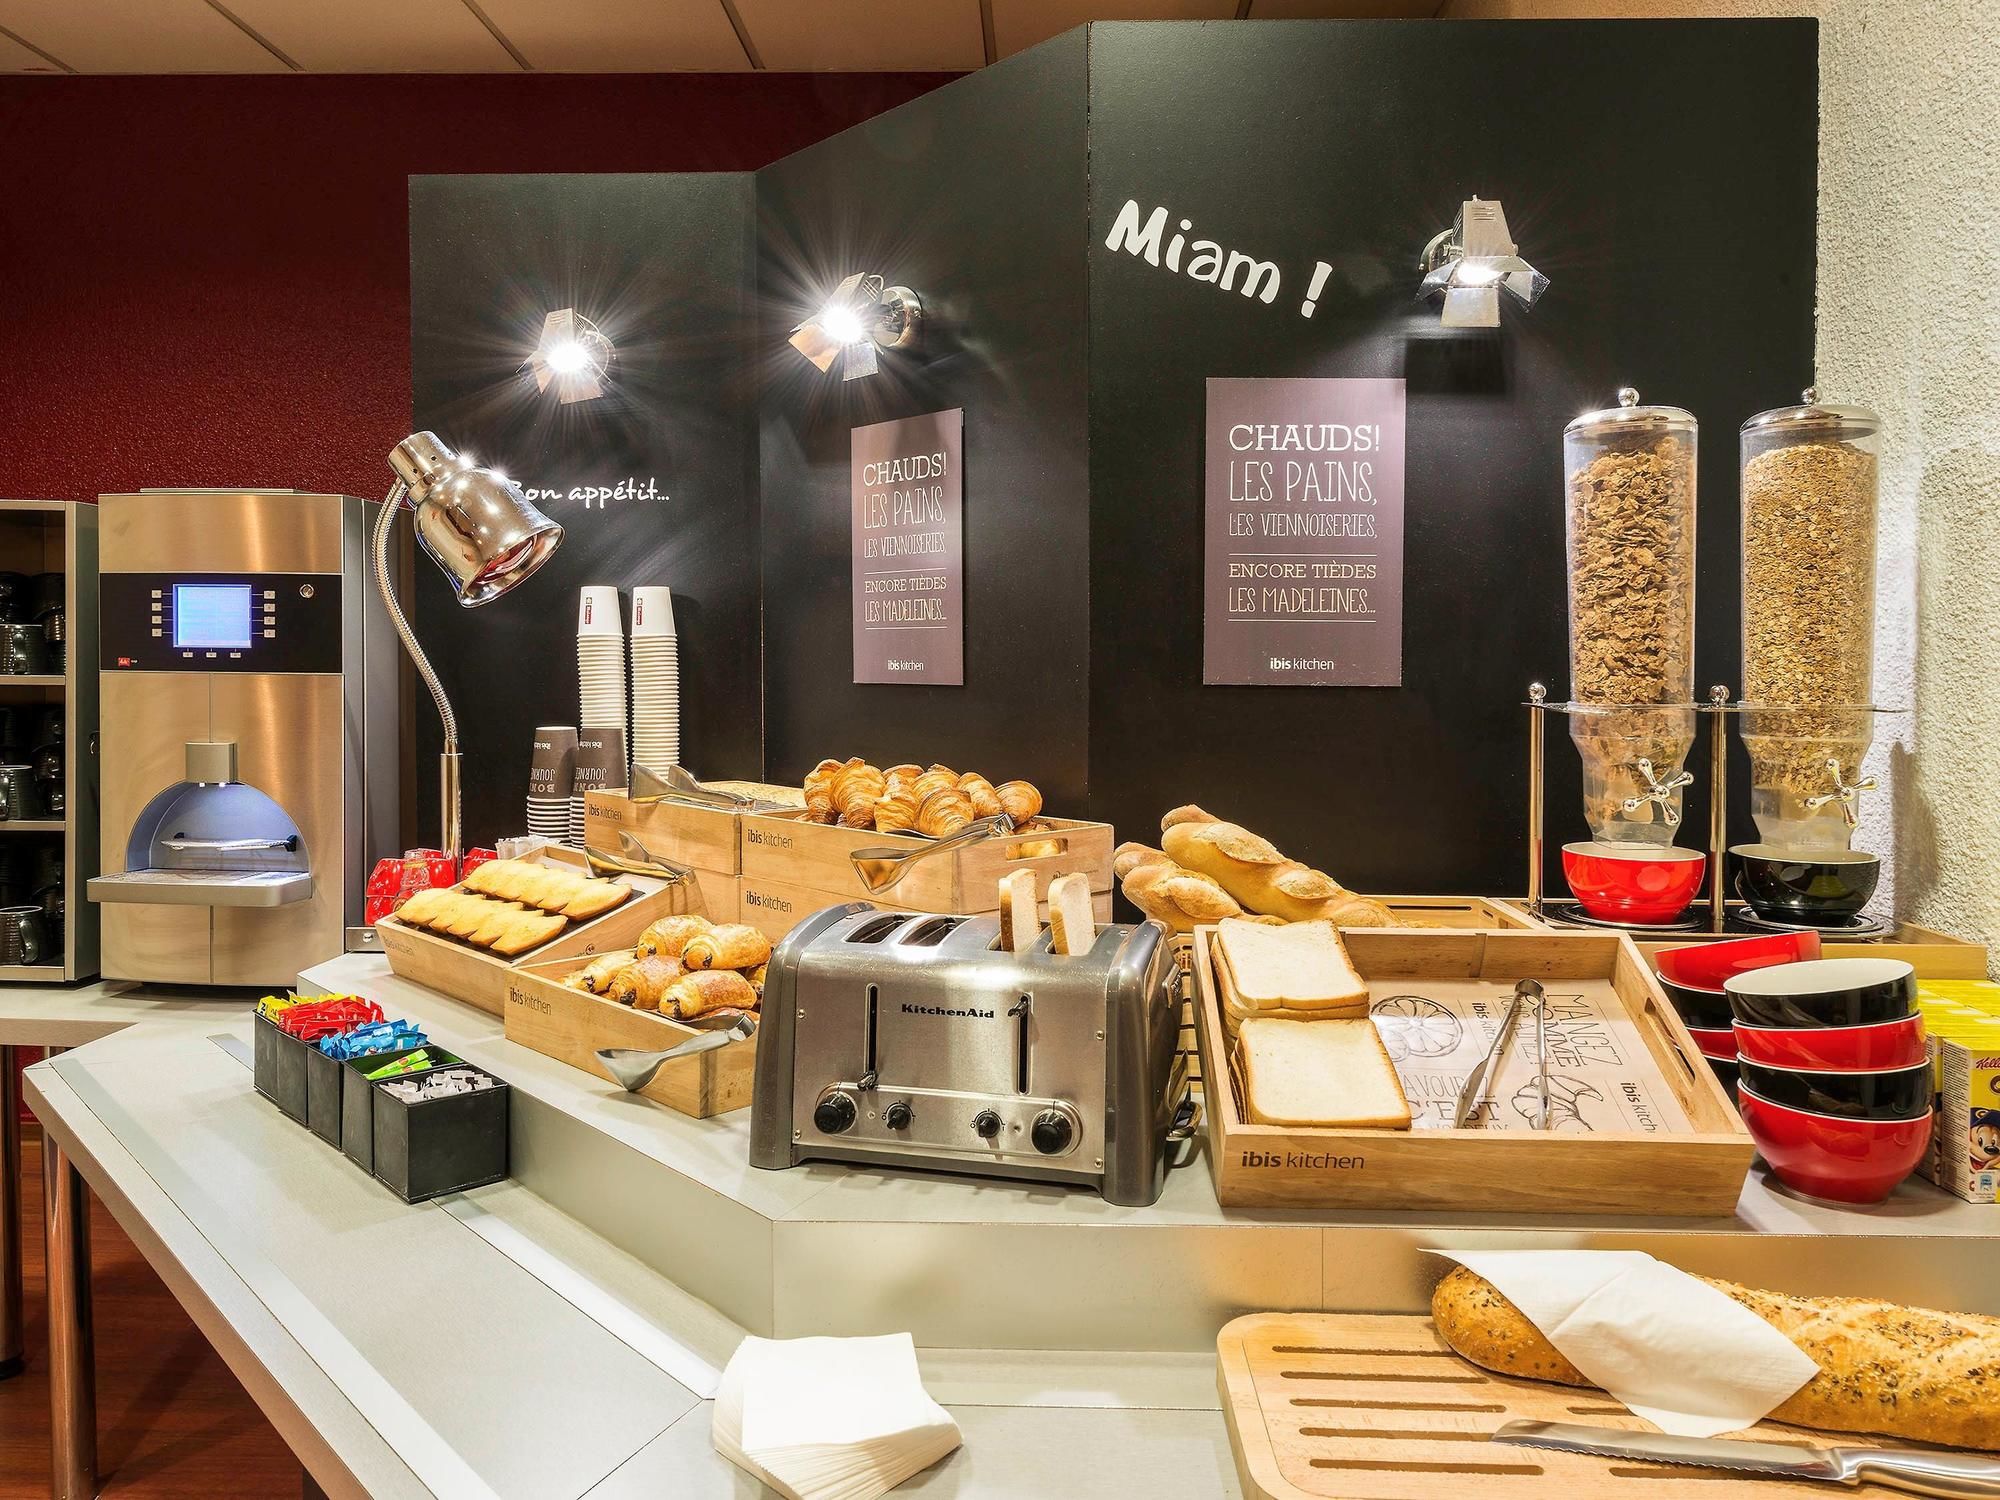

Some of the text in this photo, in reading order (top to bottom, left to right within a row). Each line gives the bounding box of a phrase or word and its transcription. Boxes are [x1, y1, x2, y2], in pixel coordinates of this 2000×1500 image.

[1104, 199, 1333, 319] Miam !
[1229, 424, 1380, 451] CHAUDS!
[863, 452, 947, 487] CHAUDS!
[568, 477, 670, 509] appétit...
[1229, 461, 1377, 506] LES PAINS,
[864, 486, 946, 529] LES PAINS,
[1229, 513, 1378, 539] LES VIENNOISERIES,
[864, 537, 878, 559] LES
[1228, 560, 1377, 579] ENCORE TIÈDES
[864, 574, 947, 594] ENCORE TIÈDES
[865, 601, 880, 622] LES
[1229, 587, 1376, 614] LES MADELEINES...
[887, 660, 924, 672] ibis kitchen
[1270, 657, 1334, 670] ibis kitchen
[588, 803, 622, 821] ibis kitchen
[747, 828, 793, 849] ibis kitchen
[746, 890, 792, 913] ibis kitchen
[509, 987, 552, 1016] ibis kitchen
[901, 1003, 995, 1019] KitchenAid
[1472, 1002, 1490, 1019] ibis
[1524, 993, 1581, 1067] COMME
[1546, 994, 1623, 1066] MANGEZ
[1620, 1082, 1658, 1133] ibis kitch
[1241, 1151, 1365, 1169] ibis kitchen
